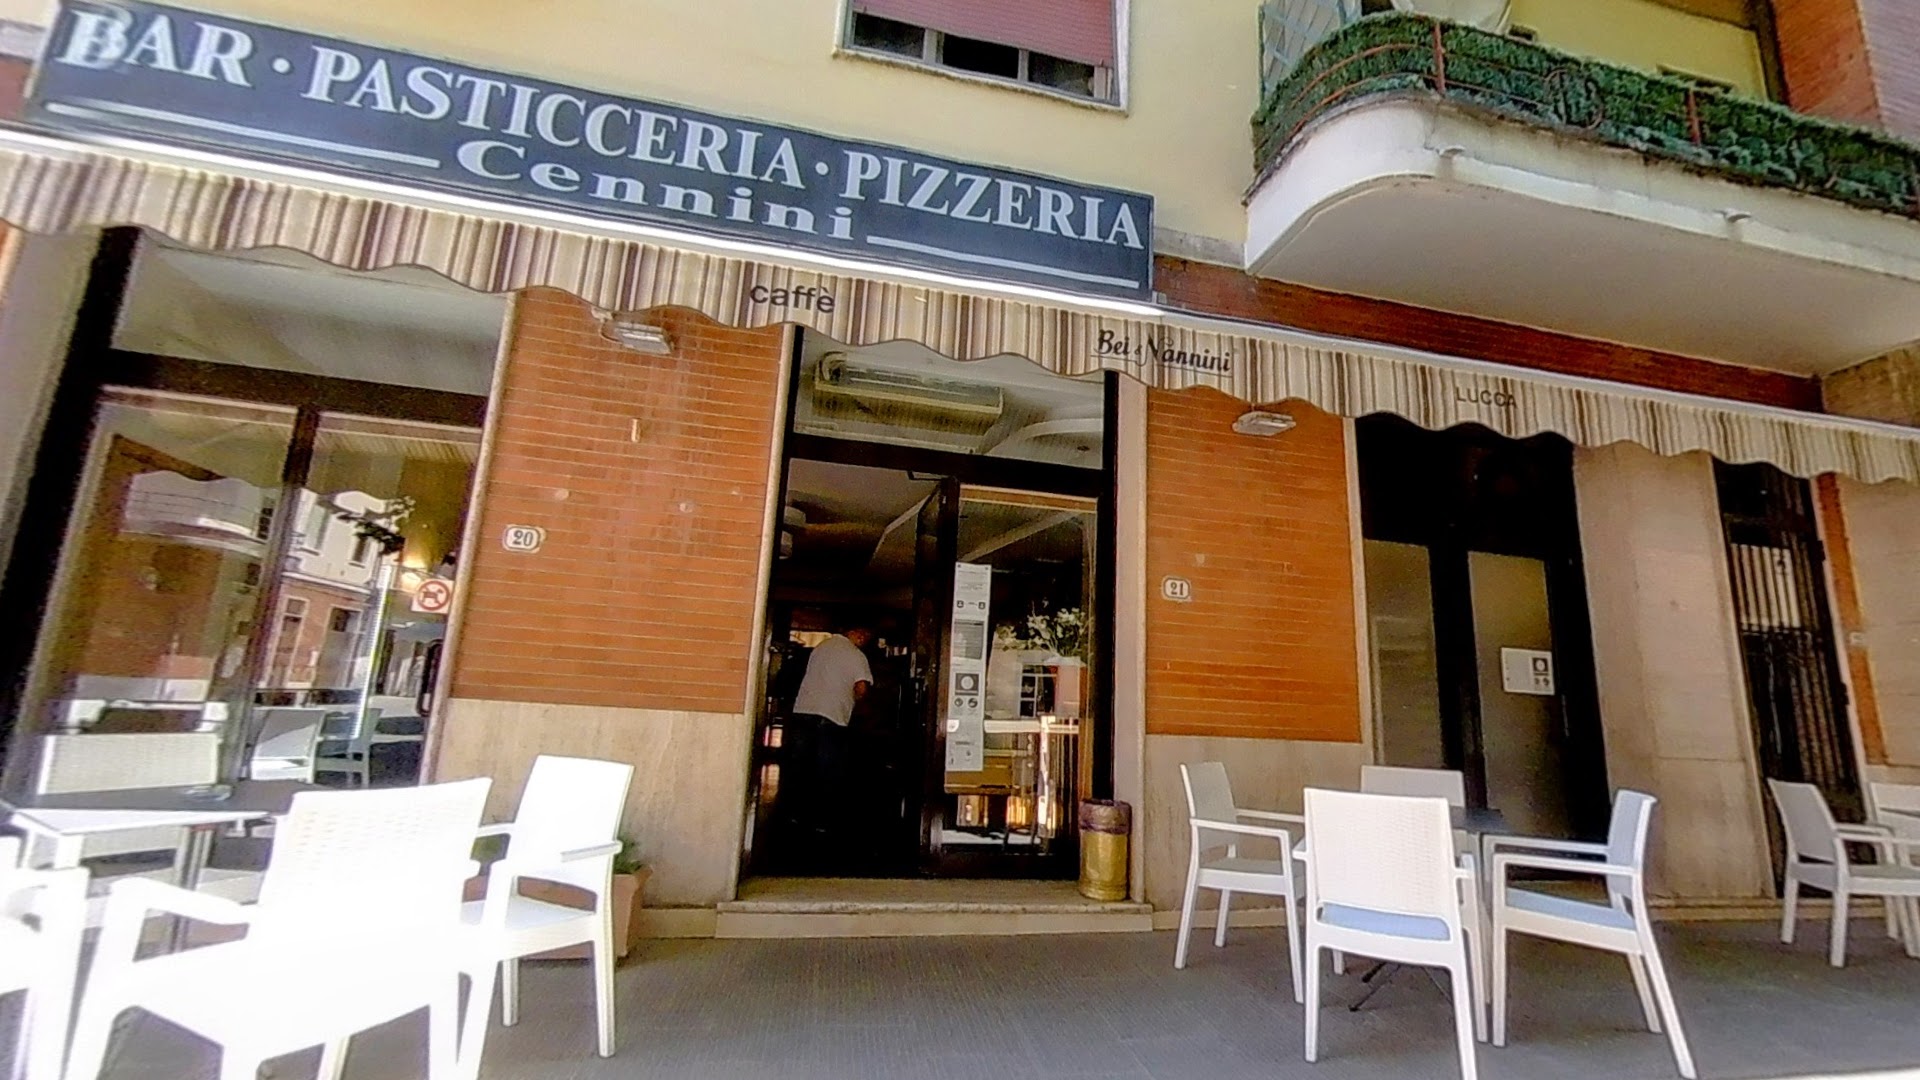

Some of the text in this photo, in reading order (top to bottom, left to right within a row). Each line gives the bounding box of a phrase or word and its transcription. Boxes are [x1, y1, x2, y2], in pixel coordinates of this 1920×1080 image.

[56, 6, 1145, 250] BAR PASTICCERIA PIZZERIA
[456, 139, 855, 241] Cennini
[750, 285, 835, 314] caffè
[1094, 328, 1130, 355] Bei
[1146, 333, 1231, 372] Nannini
[1455, 386, 1518, 409] LUCCA
[512, 530, 534, 547] 20
[1170, 582, 1184, 596] 21
